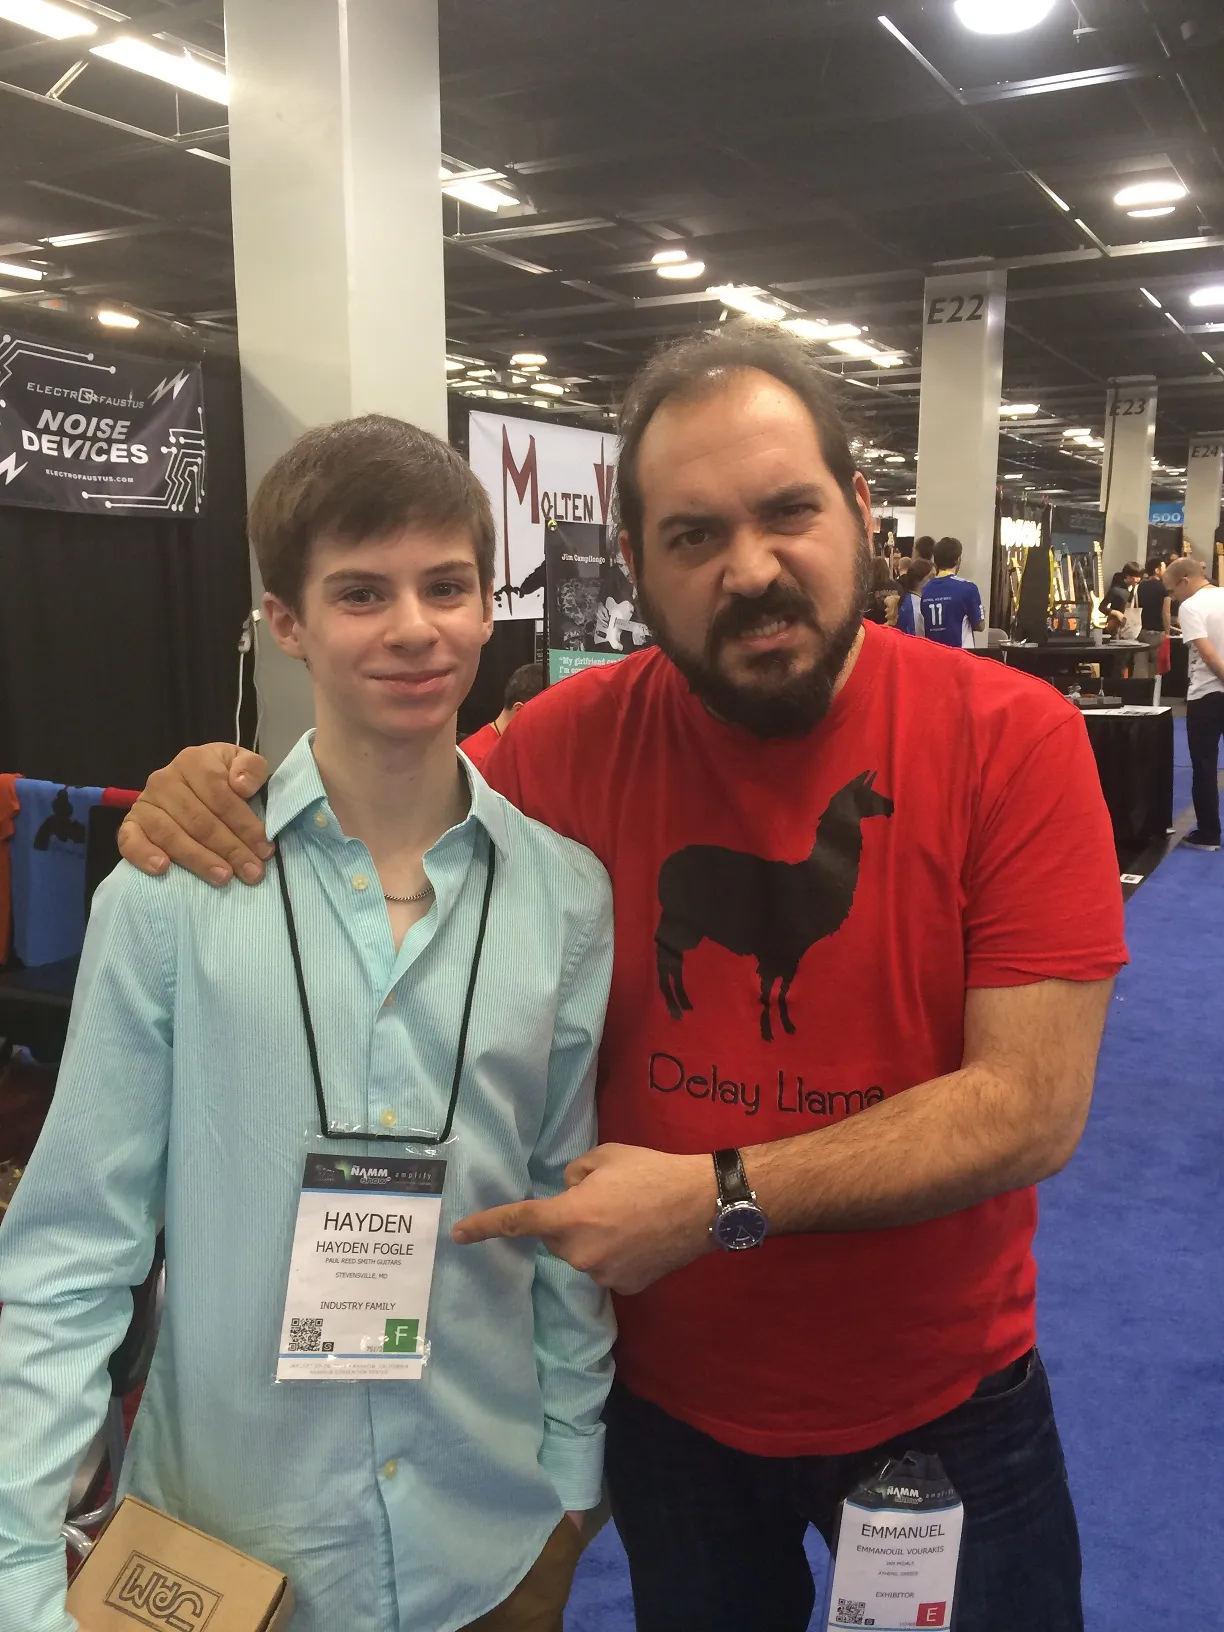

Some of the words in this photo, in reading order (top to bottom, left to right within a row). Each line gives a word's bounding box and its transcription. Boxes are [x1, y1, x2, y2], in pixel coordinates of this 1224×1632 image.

[927, 294, 985, 325] E22
[1109, 399, 1148, 417] E23
[37, 409, 131, 440] NOISE
[21, 430, 149, 464] DEVICES
[1191, 445, 1219, 459] E24
[45, 468, 134, 483] ELECTROFAUSTUS.COM
[1152, 512, 1182, 523] 500
[561, 553, 574, 561] Jim
[929, 603, 942, 626] 11
[649, 1052, 761, 1115] Delay
[323, 1211, 413, 1234] HAYDEN
[316, 1240, 369, 1255] HAYDEN
[373, 1243, 414, 1256] FOGLE
[320, 1301, 363, 1311] INDUSTRY
[365, 1302, 396, 1312] FAMILY
[395, 1325, 409, 1346] F
[861, 1523, 945, 1539] EMMANUEL
[856, 1545, 904, 1556] EMMANOUIL
[907, 1545, 944, 1556] VOURAKIS
[875, 1591, 915, 1599] EXHIBITOR
[926, 1607, 938, 1622] E
